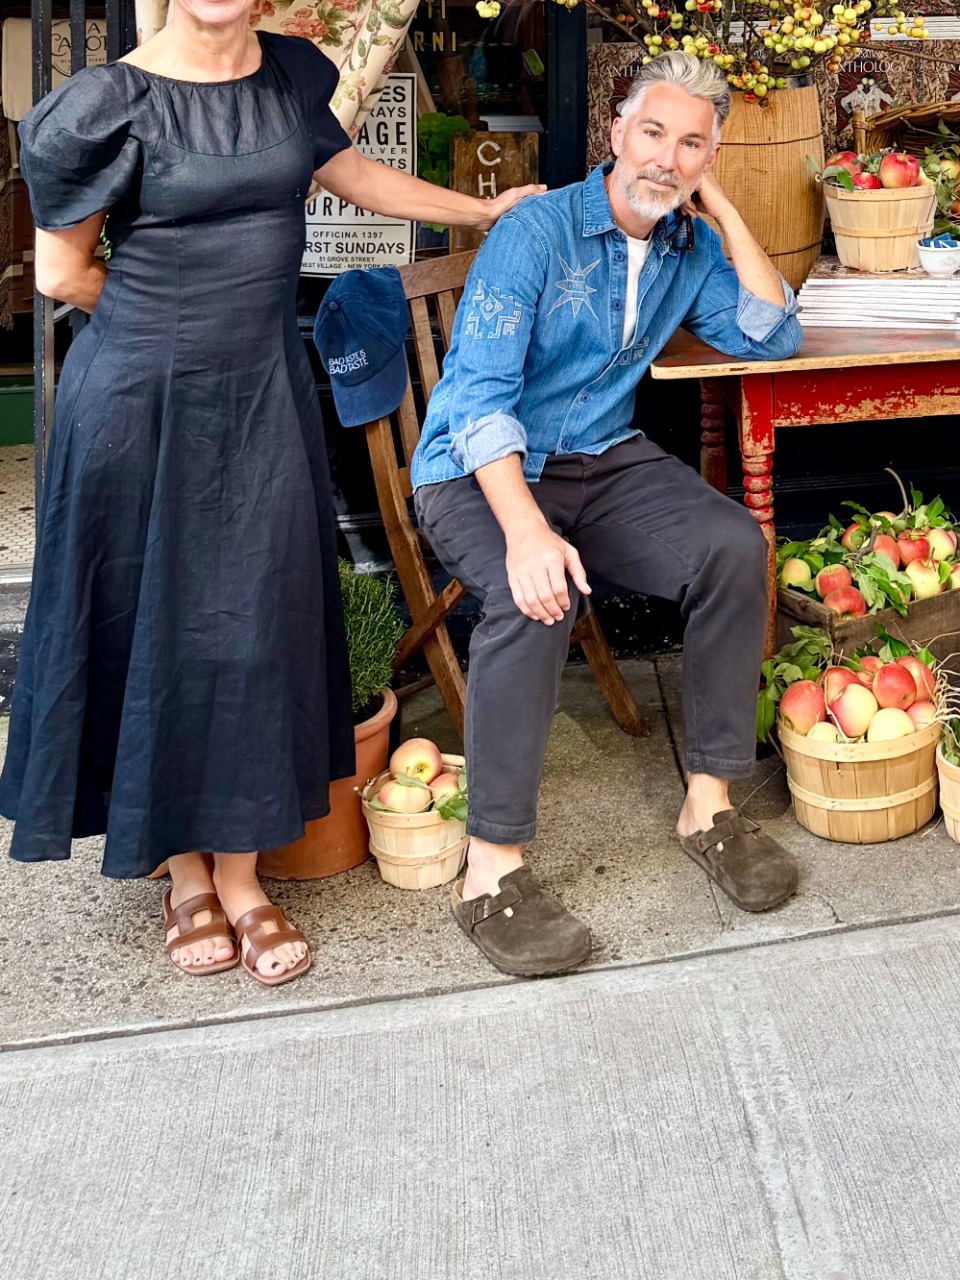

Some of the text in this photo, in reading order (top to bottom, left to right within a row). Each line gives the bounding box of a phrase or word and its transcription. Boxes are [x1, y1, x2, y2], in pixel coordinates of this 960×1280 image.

[312, 231, 384, 239] OFFICINA 1397
[304, 242, 405, 254] RST SUNDAYS
[328, 357, 345, 366] BAD
[329, 357, 369, 375] BAD TASTE
